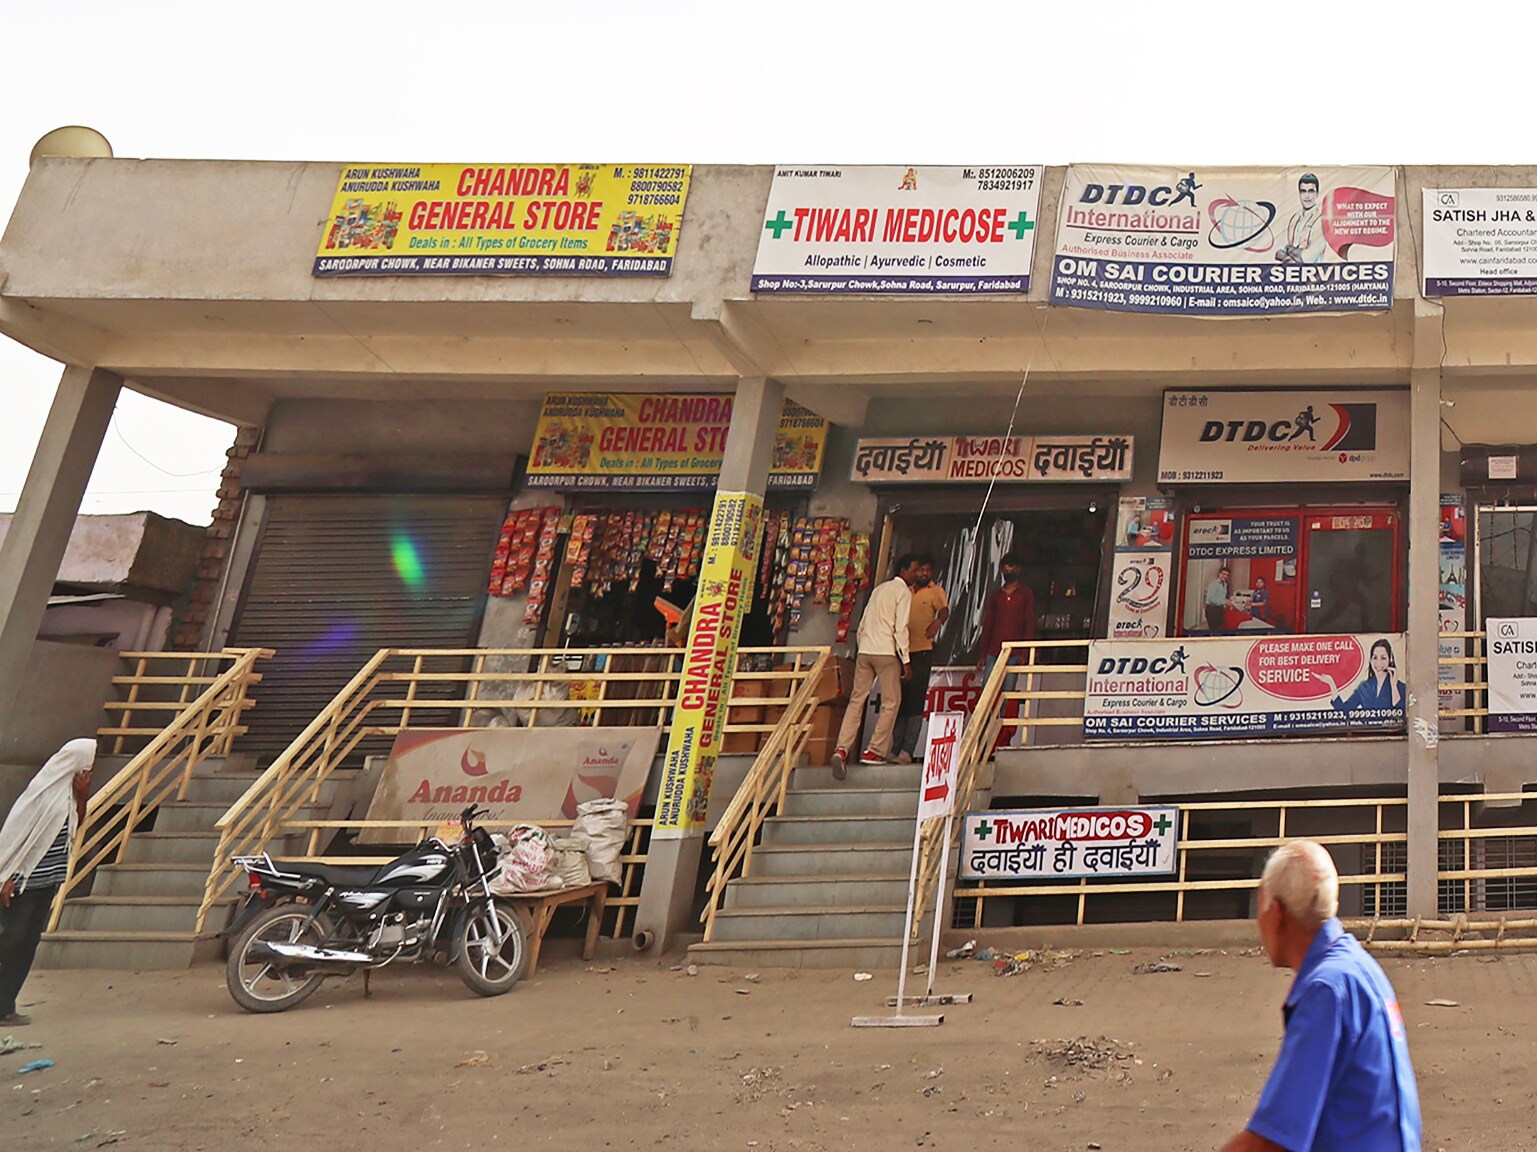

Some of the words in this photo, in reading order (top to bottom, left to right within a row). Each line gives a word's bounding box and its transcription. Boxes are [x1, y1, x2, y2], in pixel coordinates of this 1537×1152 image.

[345, 169, 372, 180] ARUN
[372, 168, 420, 179] KUSHWAHA
[633, 168, 685, 179] 9811422791
[777, 170, 794, 178] AMIT
[794, 170, 818, 178] KUMAR
[978, 168, 1035, 180] 8512006209
[341, 181, 388, 192] ANURUDDA
[391, 181, 440, 192] KUSHWAHA
[457, 167, 570, 197] CHANDRA
[630, 181, 683, 192] 8800790582
[978, 180, 1034, 190] 7834921917
[1080, 184, 1172, 206] DTDC
[408, 201, 515, 231] GENERAL
[523, 201, 603, 231] STORE
[1066, 205, 1200, 230] International
[1433, 210, 1486, 222] SATISH
[1491, 210, 1521, 222] JHA
[1525, 210, 1536, 222] &
[794, 208, 878, 242] TIWARI
[882, 208, 1007, 243] MEDICOSE
[1456, 228, 1496, 237] Chartered
[409, 236, 437, 248] Deals
[440, 236, 449, 248] in
[458, 236, 473, 248] All
[476, 236, 503, 250] Types
[506, 236, 517, 248] of
[518, 236, 558, 251] Grocery
[560, 237, 588, 249] Items
[1084, 232, 1122, 246] Express
[1125, 235, 1158, 246] Courier
[1160, 236, 1168, 246] &
[1170, 236, 1198, 250] Cargo
[1062, 244, 1109, 256] Authorised
[1112, 248, 1150, 259] Business
[1152, 250, 1194, 260] Associate
[422, 258, 450, 269] NEAR
[452, 258, 495, 269] BIKANER
[497, 258, 540, 270] SWEETS,
[543, 258, 576, 270] SOHNA
[578, 258, 608, 272] ROAD,
[611, 259, 667, 272] FARIDABAD
[805, 254, 861, 268] Allopathic
[870, 254, 926, 268] Ayurvedic
[936, 255, 986, 267] Cosmetic
[1058, 258, 1098, 277] OM
[1104, 262, 1145, 280] SAI
[1152, 266, 1262, 283] COURIER
[1269, 264, 1389, 282] SERVICES
[758, 280, 780, 290] Shop
[978, 280, 1021, 290] Faridabad
[1334, 294, 1388, 304] www.dtdc.in
[638, 398, 732, 423] CHANDRA
[600, 426, 688, 452] GENERAL
[1199, 420, 1292, 442] DTDC
[955, 437, 1022, 458] TIWARI
[950, 459, 1026, 478] MEDICOS
[1189, 547, 1214, 556] DTDC
[1216, 546, 1256, 556] EXPRESS
[1258, 546, 1294, 554] LIMITED
[1260, 644, 1290, 654] PLEASE
[1292, 643, 1314, 652] MAKE
[1316, 642, 1332, 651] ONE
[1334, 641, 1354, 650] CALL
[681, 601, 722, 711] CHANDRA
[700, 646, 729, 748] GENERAL
[720, 568, 742, 639] STORE
[1259, 656, 1276, 667] FOR
[1278, 656, 1299, 666] BEST
[1301, 654, 1340, 665] DELIVERY
[1097, 658, 1168, 674] DTDC
[1258, 668, 1310, 684] SERVICE
[1088, 676, 1189, 694] International
[1102, 698, 1130, 709] Express
[1132, 698, 1158, 708] Courier
[1166, 698, 1188, 709] Cargo
[1086, 717, 1106, 728] OM
[1110, 717, 1132, 727] SAI
[1136, 716, 1197, 727] COURIER
[1201, 714, 1267, 726] SERVICES
[678, 727, 695, 775] KUSHWAHA
[583, 756, 619, 766] Ananda
[664, 750, 680, 800] KUSHWAHA
[408, 779, 522, 804] Ananda
[659, 801, 670, 826] ARUN
[994, 817, 1055, 844] TIWARI
[1056, 814, 1145, 840] MEDICOS
[1053, 840, 1077, 873] ही
